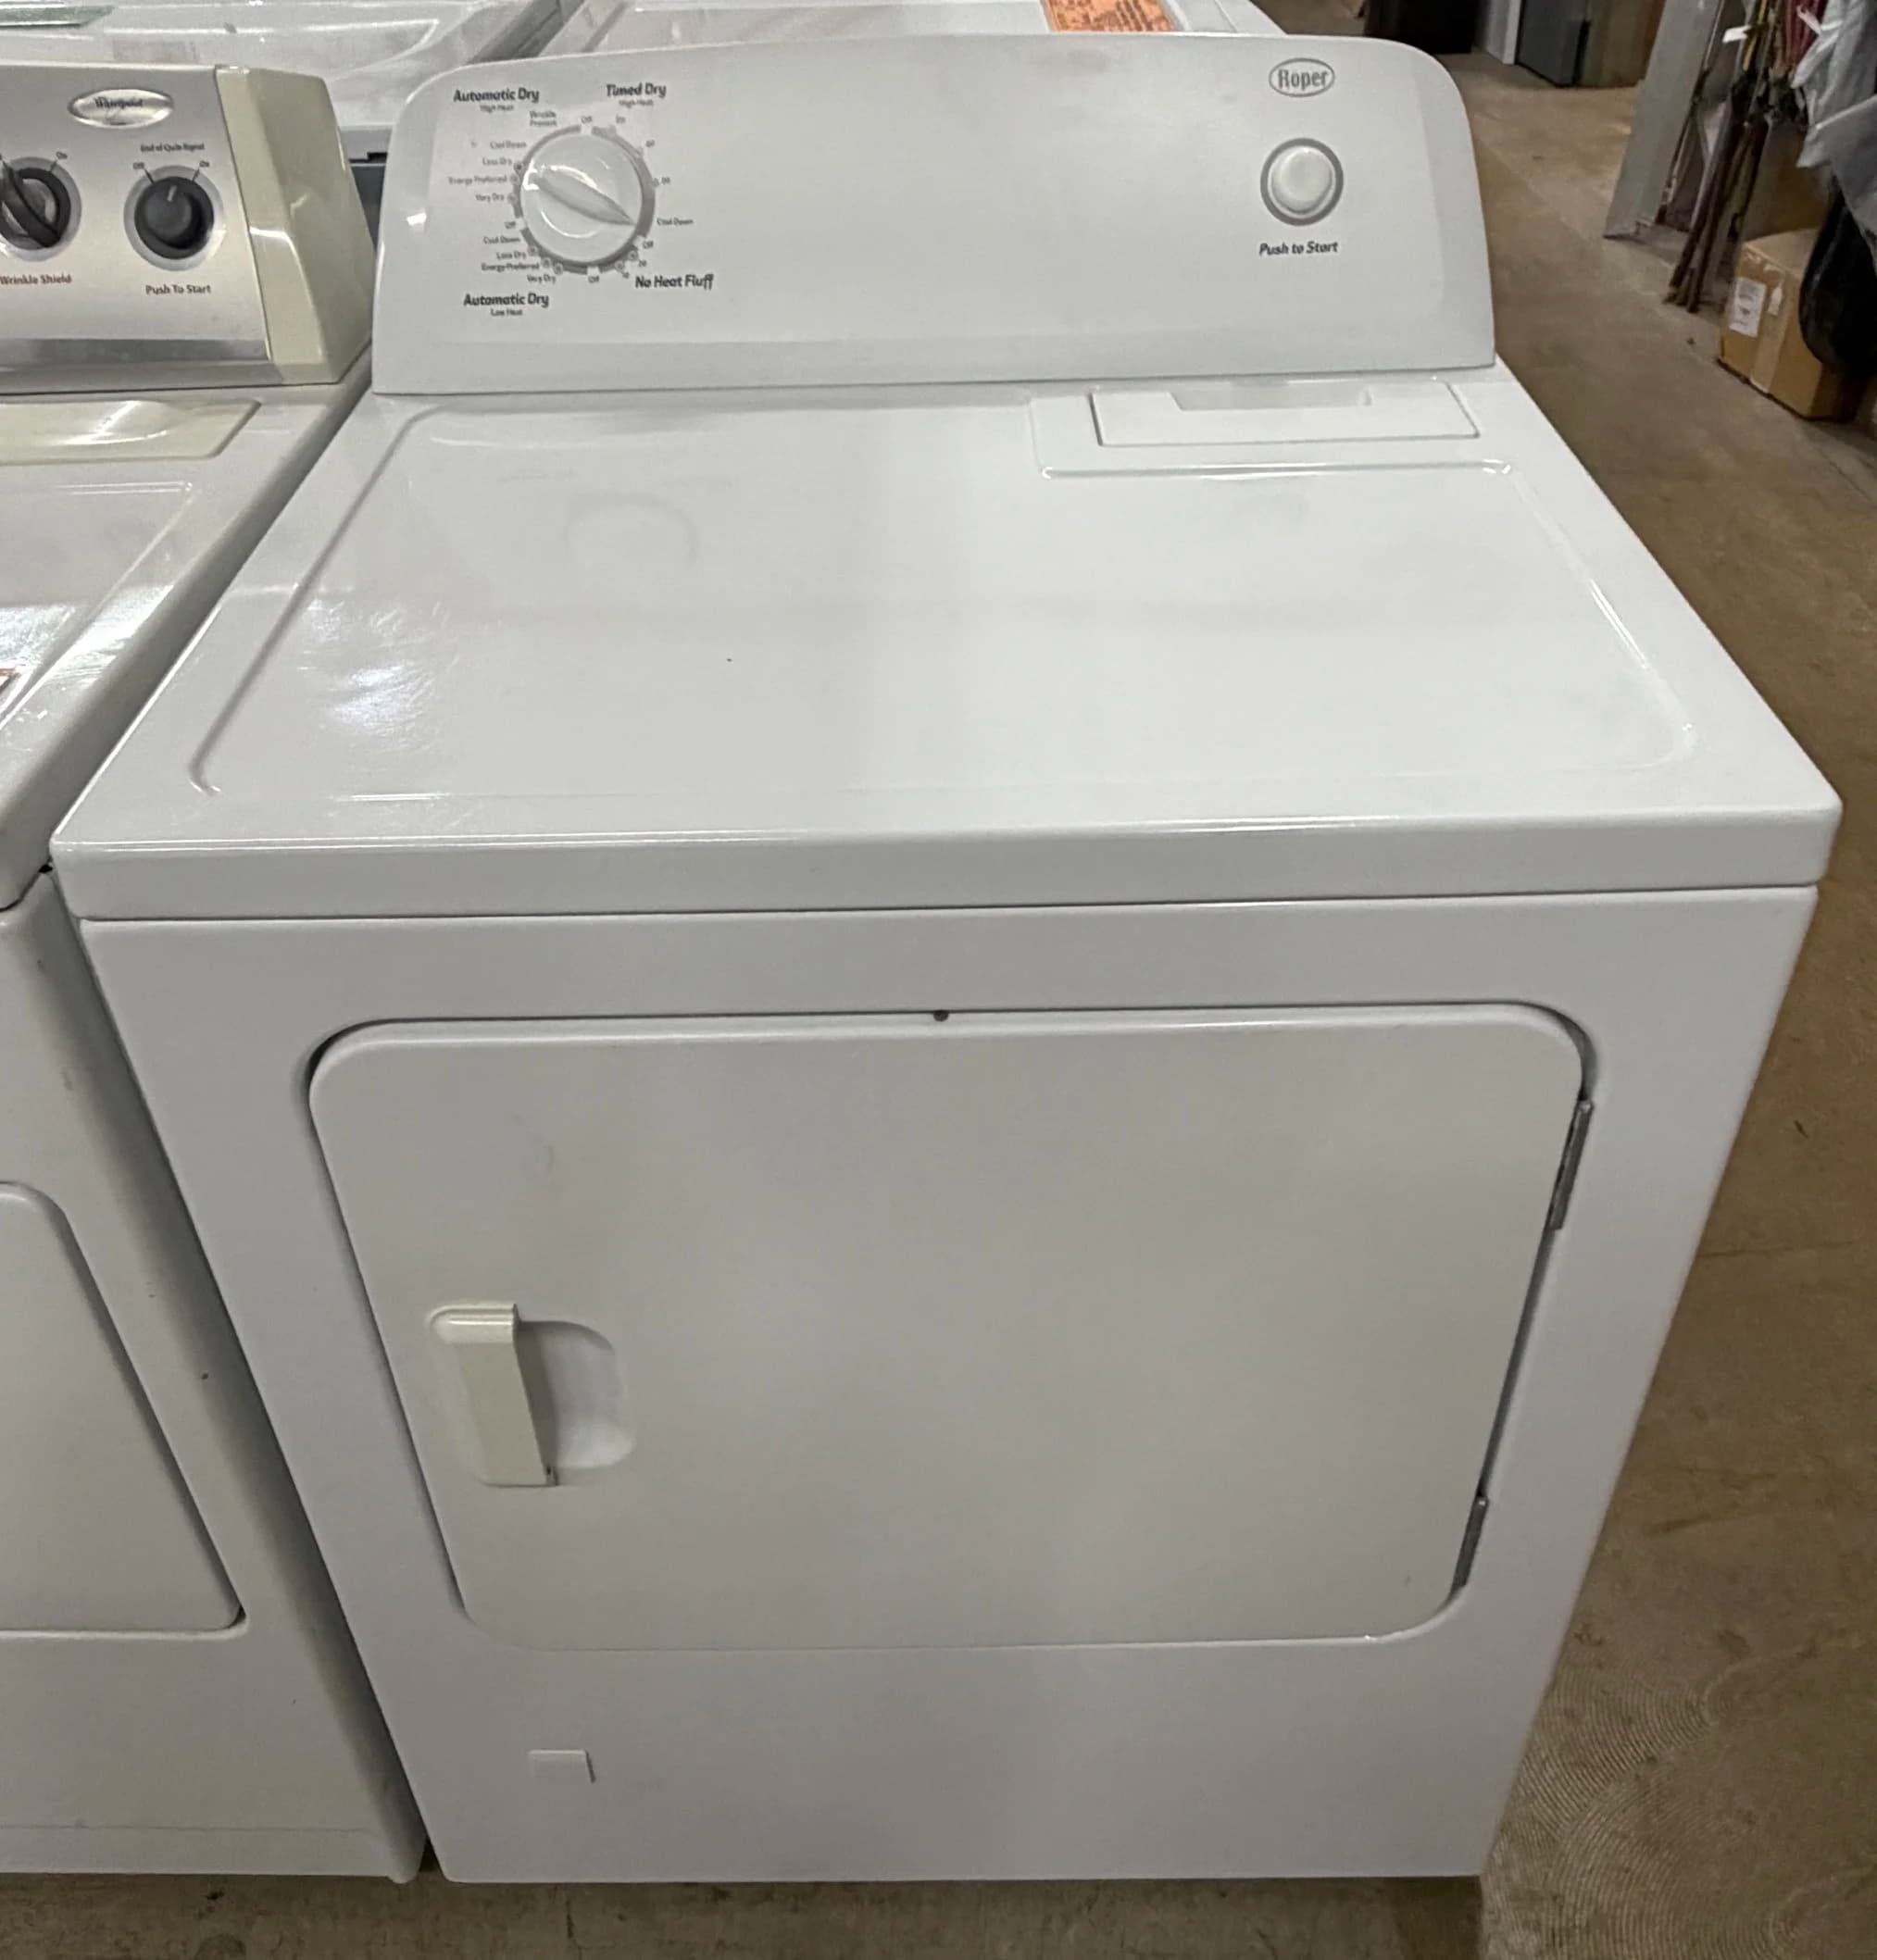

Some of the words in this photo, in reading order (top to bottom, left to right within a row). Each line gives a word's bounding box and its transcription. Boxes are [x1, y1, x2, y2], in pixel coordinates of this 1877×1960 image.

[1278, 69, 1328, 91] Roper
[453, 88, 515, 102] Automatic
[518, 87, 540, 104] Dry
[607, 81, 643, 96] Timed
[644, 82, 667, 98] Dry
[1258, 243, 1288, 256] Push
[1291, 243, 1304, 254] to
[1306, 241, 1338, 254] Start
[41, 274, 72, 284] Shield
[635, 275, 651, 288] No
[653, 275, 682, 288] Heat
[684, 273, 714, 290] Fluff
[145, 284, 169, 295] Push
[172, 285, 184, 293] To
[186, 284, 211, 294] Start
[463, 292, 526, 306] Automatic
[528, 293, 549, 308] Dry
